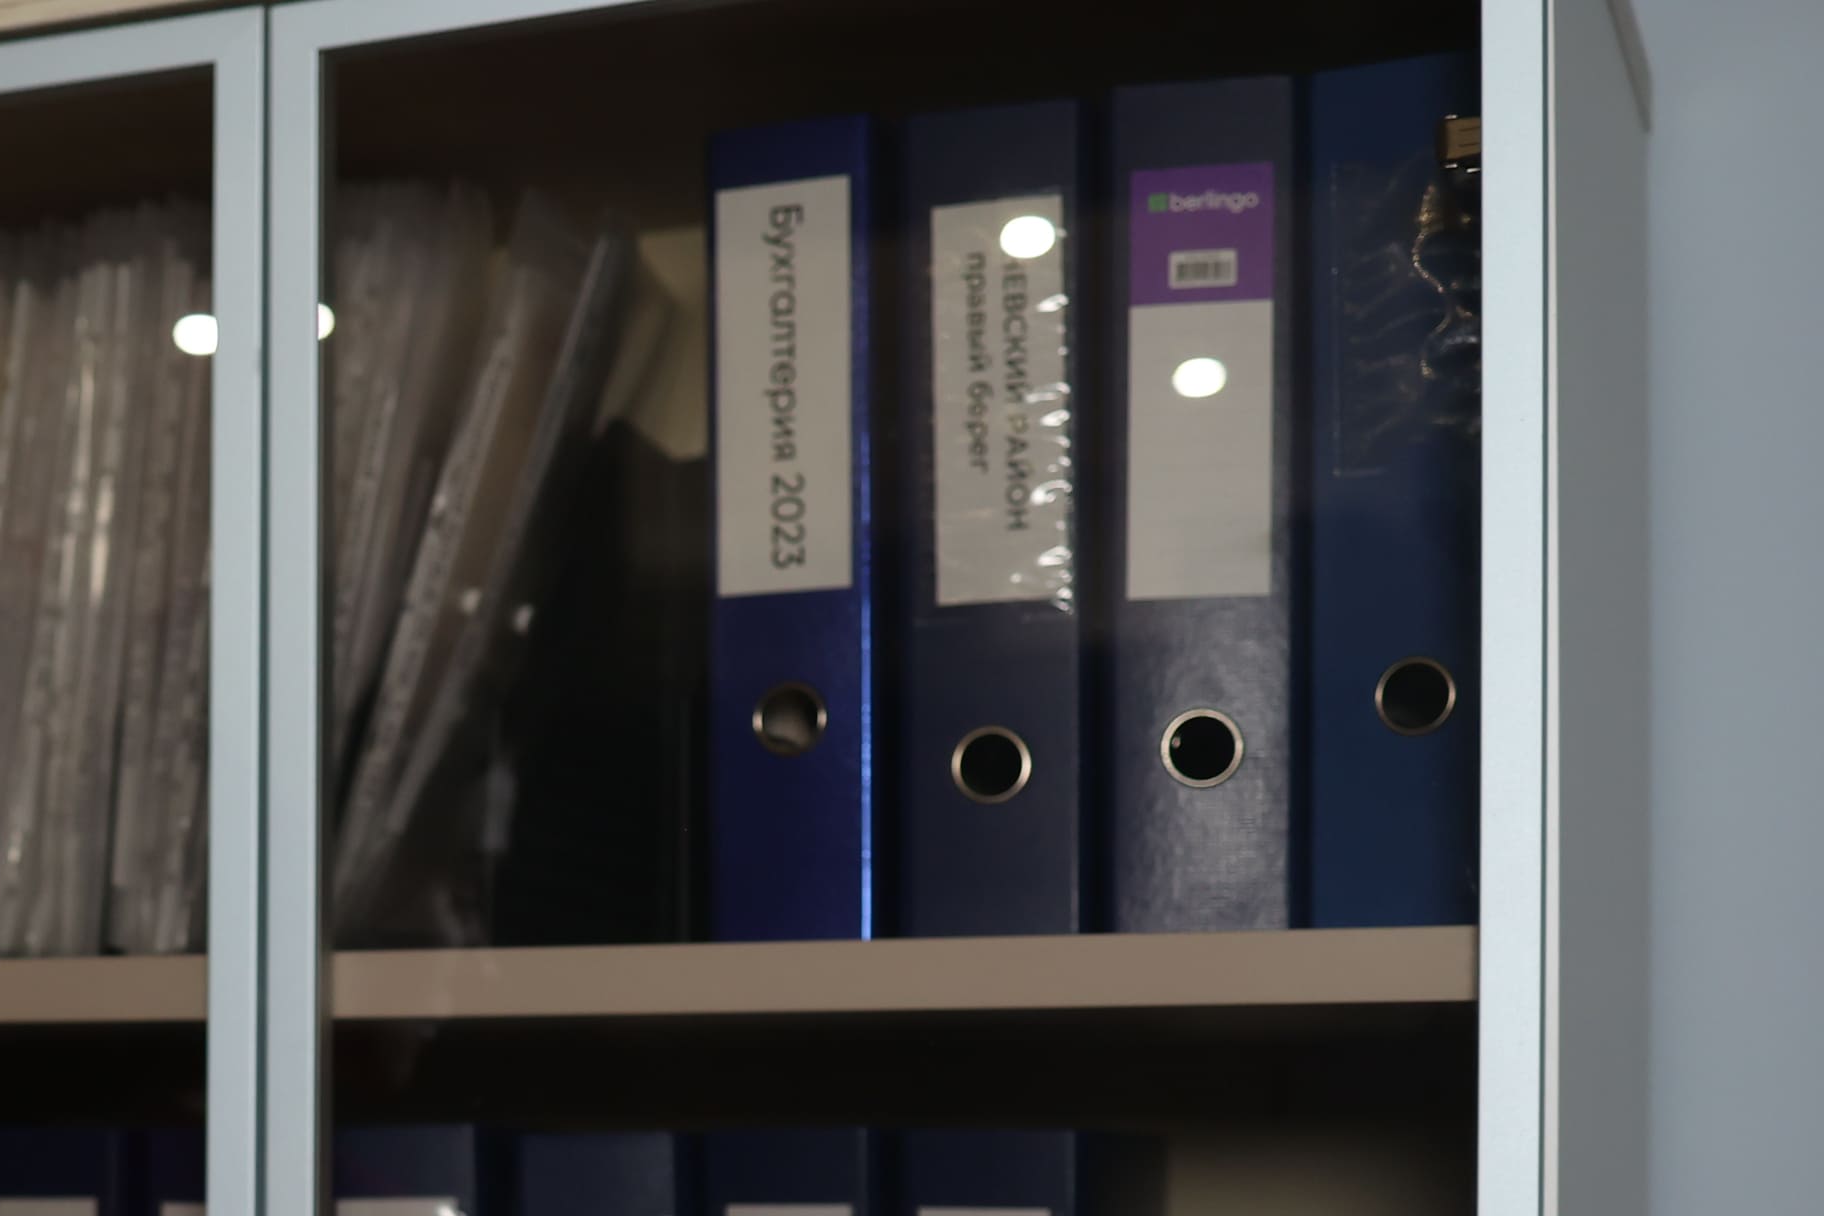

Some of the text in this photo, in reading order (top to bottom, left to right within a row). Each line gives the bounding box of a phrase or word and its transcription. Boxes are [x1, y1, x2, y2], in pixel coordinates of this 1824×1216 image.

[1169, 189, 1259, 214] berlingo
[763, 204, 805, 570] Бухгалтерия 2023
[963, 252, 993, 472] правый берег
[1004, 415, 1035, 531] РАЙОН
